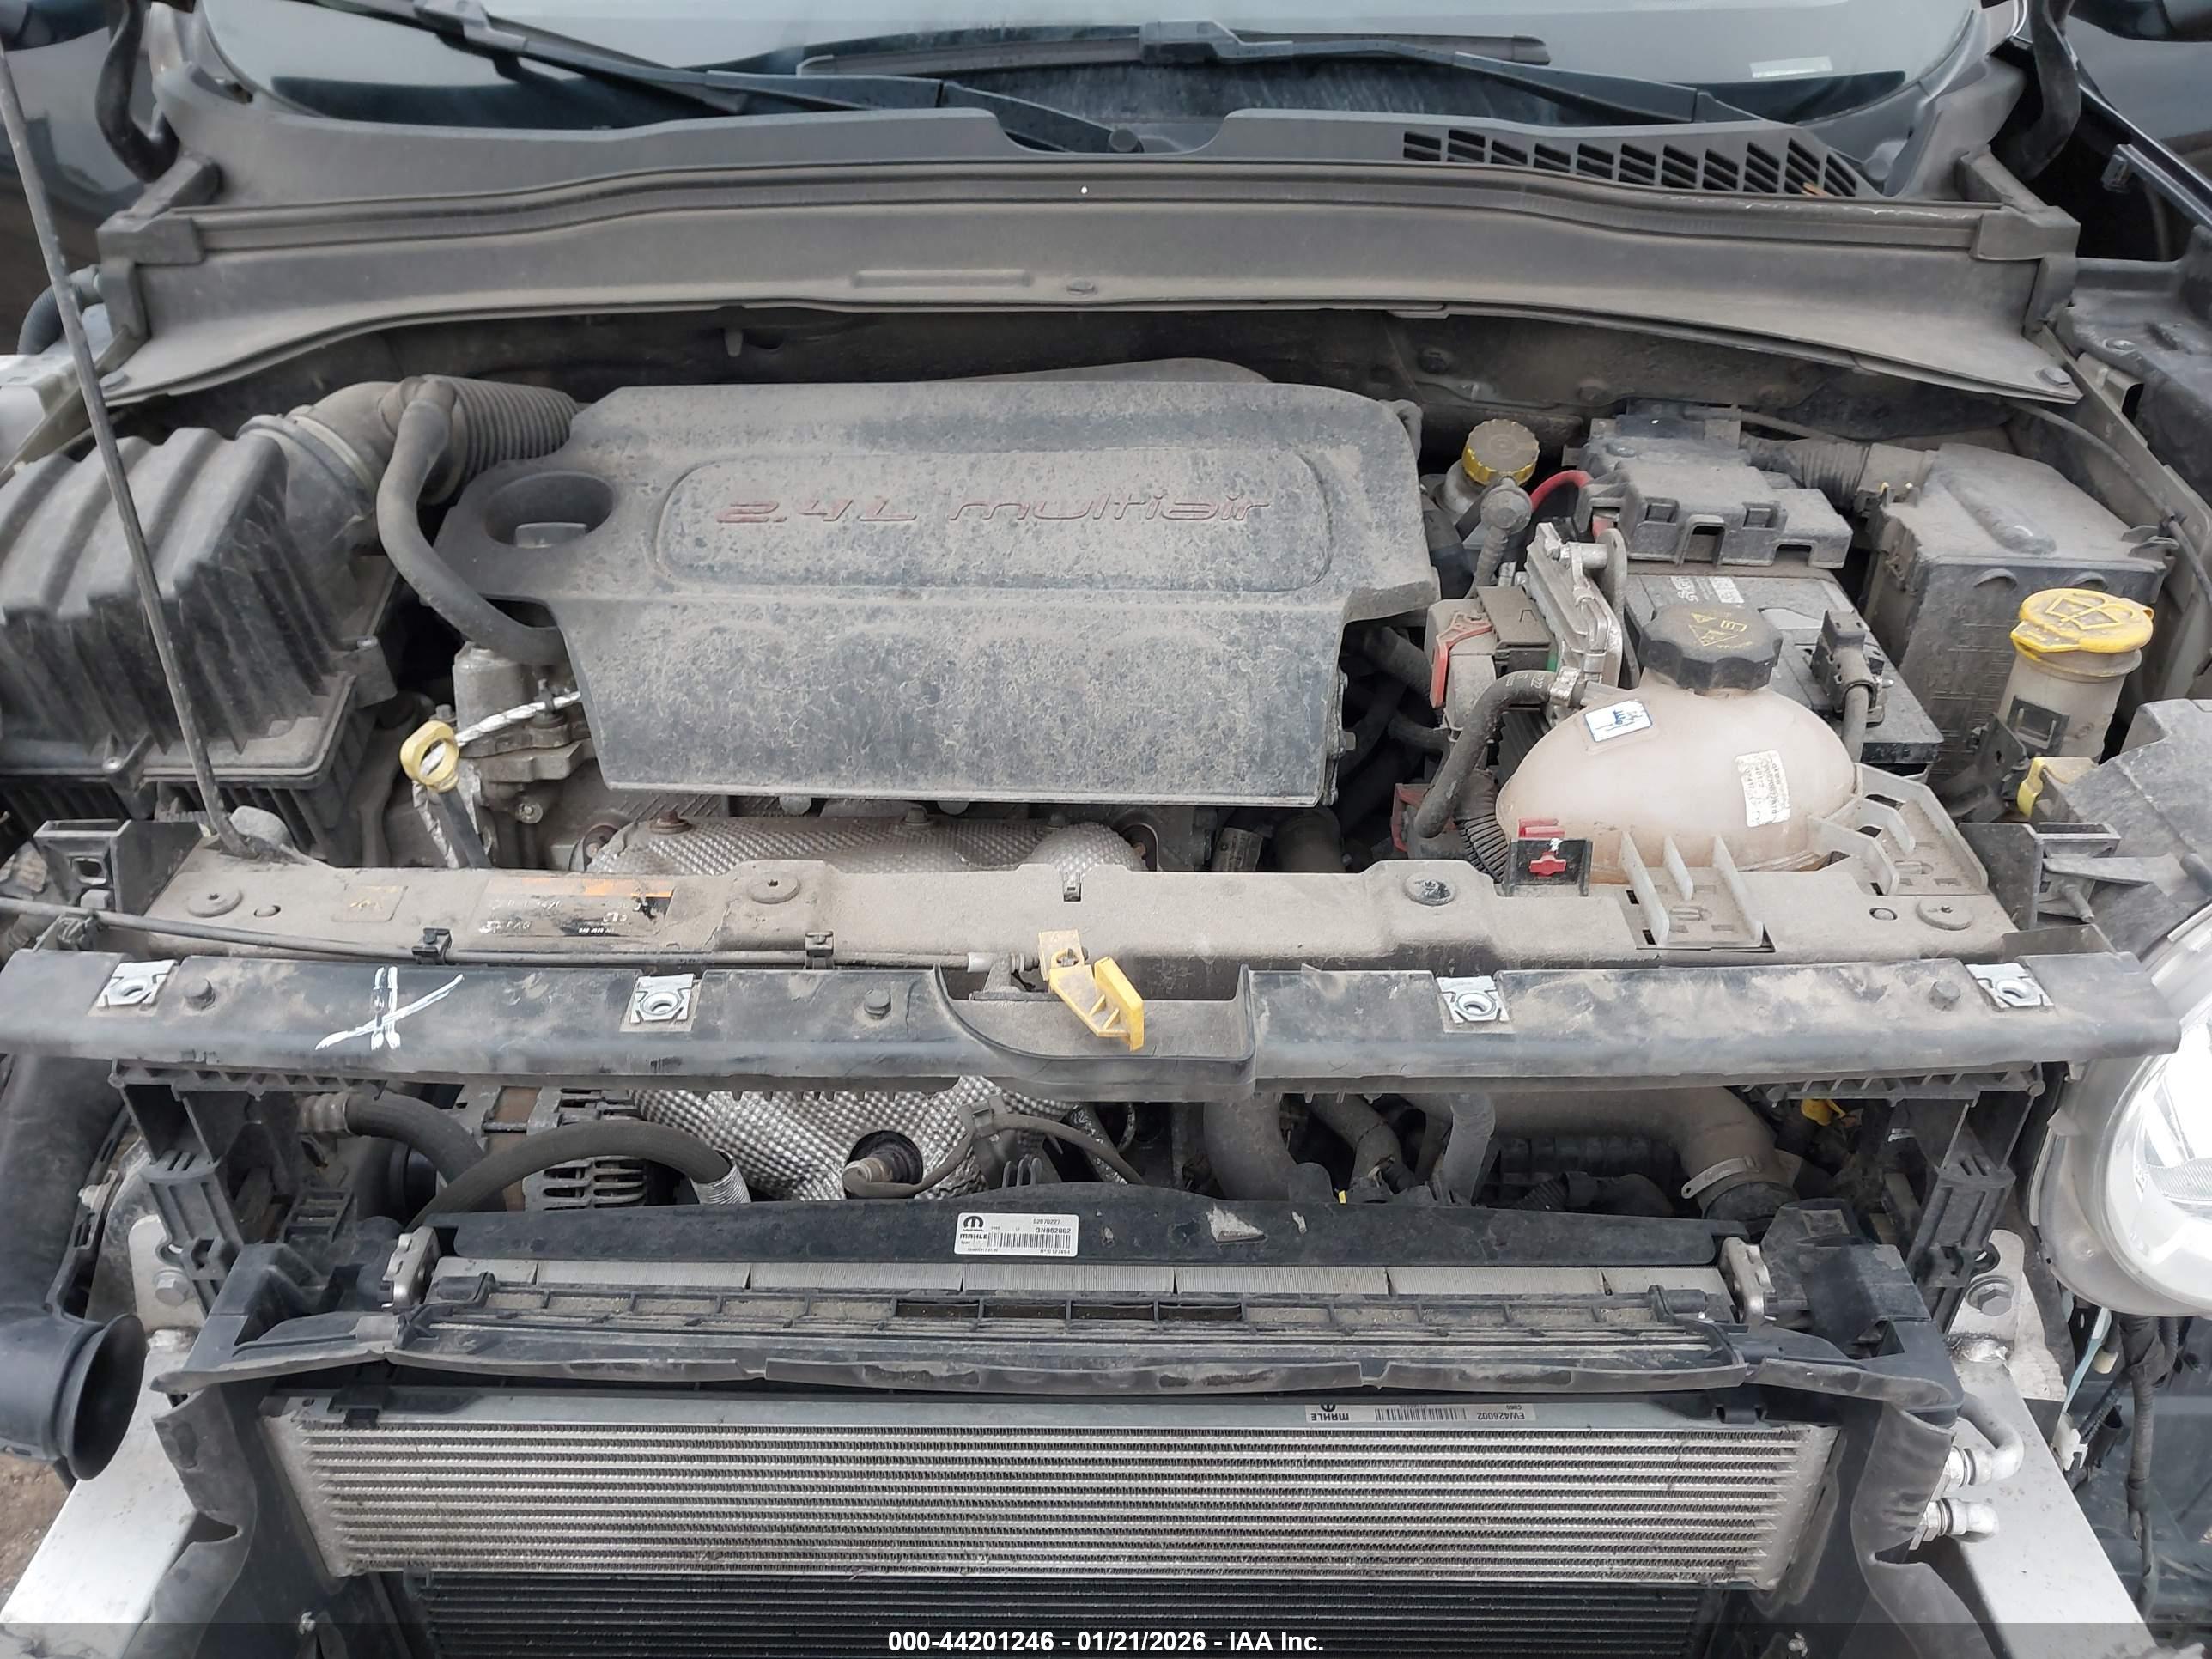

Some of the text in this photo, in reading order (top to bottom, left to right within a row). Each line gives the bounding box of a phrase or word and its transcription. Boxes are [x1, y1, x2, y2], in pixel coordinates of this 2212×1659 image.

[716, 493, 1272, 524] 2.4L multiair
[1311, 1413, 1350, 1421] MAHLE
